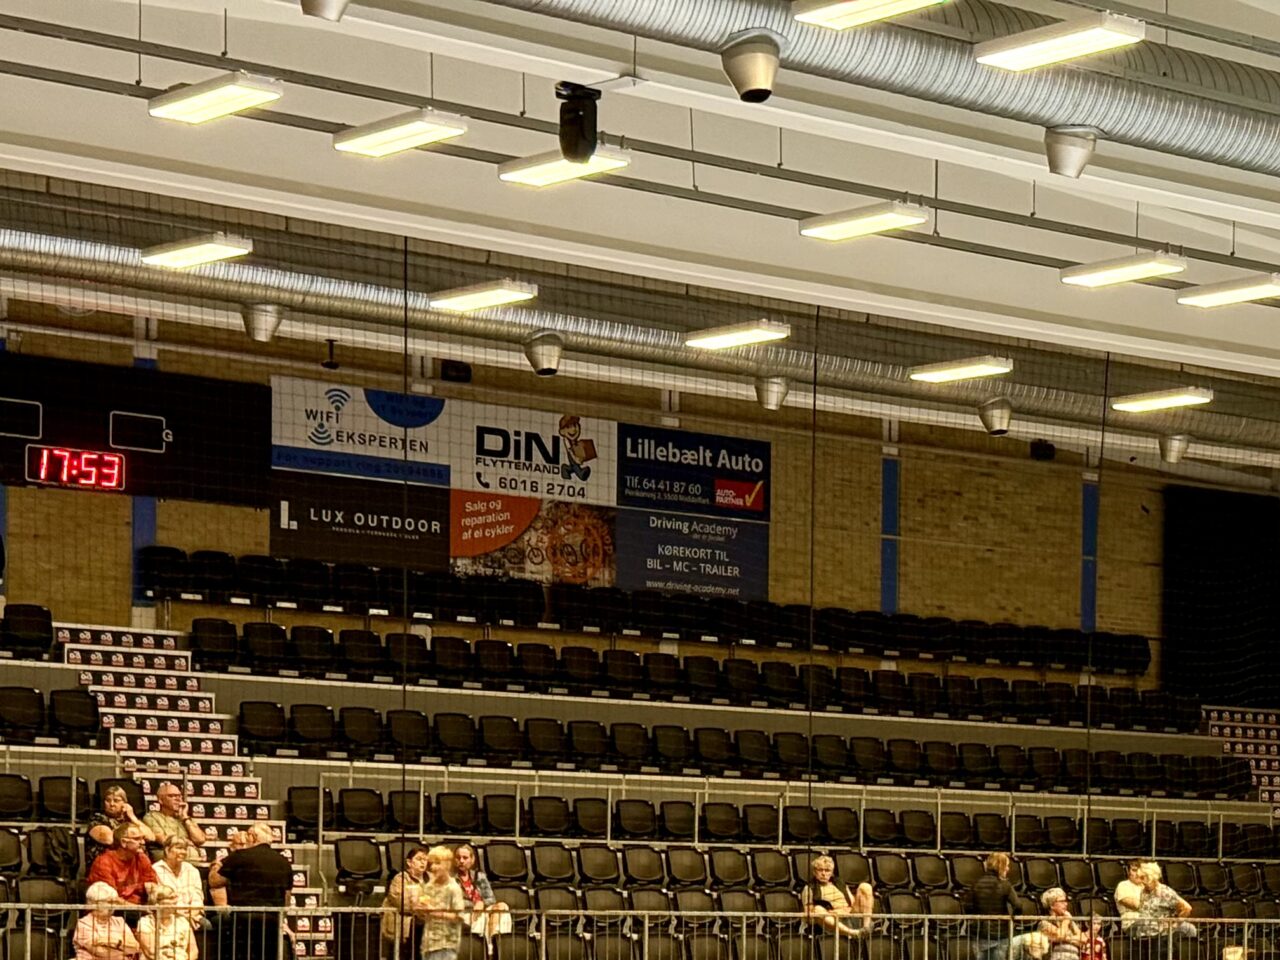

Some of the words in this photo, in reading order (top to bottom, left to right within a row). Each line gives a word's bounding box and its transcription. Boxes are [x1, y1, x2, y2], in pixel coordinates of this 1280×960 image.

[304, 408, 340, 424] WIFI
[335, 430, 430, 453] EKSPERTEN
[475, 425, 561, 465] DiN
[625, 437, 713, 468] Lillebælt
[716, 449, 764, 473] Auto
[39, 448, 120, 487] 17:53
[475, 456, 561, 475] FLYTTEMAND
[498, 476, 539, 494] 6016
[546, 482, 587, 499] 2704
[624, 475, 641, 489] Tlf.
[642, 478, 656, 490] 64
[657, 479, 671, 492] 41
[673, 481, 686, 494] 87
[688, 482, 702, 496] 60
[464, 500, 488, 513] Salg
[488, 499, 502, 511] og
[715, 495, 745, 506] PARTNER
[309, 507, 345, 524] LUX
[353, 512, 442, 534] OUTDOOR
[461, 512, 511, 528] reparation
[649, 516, 690, 534] Driving
[690, 521, 739, 539] Academy
[461, 530, 472, 541] af
[473, 528, 484, 538] el
[485, 525, 515, 539] cykler
[657, 543, 712, 560] KØREKORT
[714, 550, 730, 562] TIL
[646, 558, 663, 571] BIL
[672, 560, 690, 573] MC
[699, 563, 740, 577] TRAILER
[646, 580, 740, 597] www.driving-academy.net
